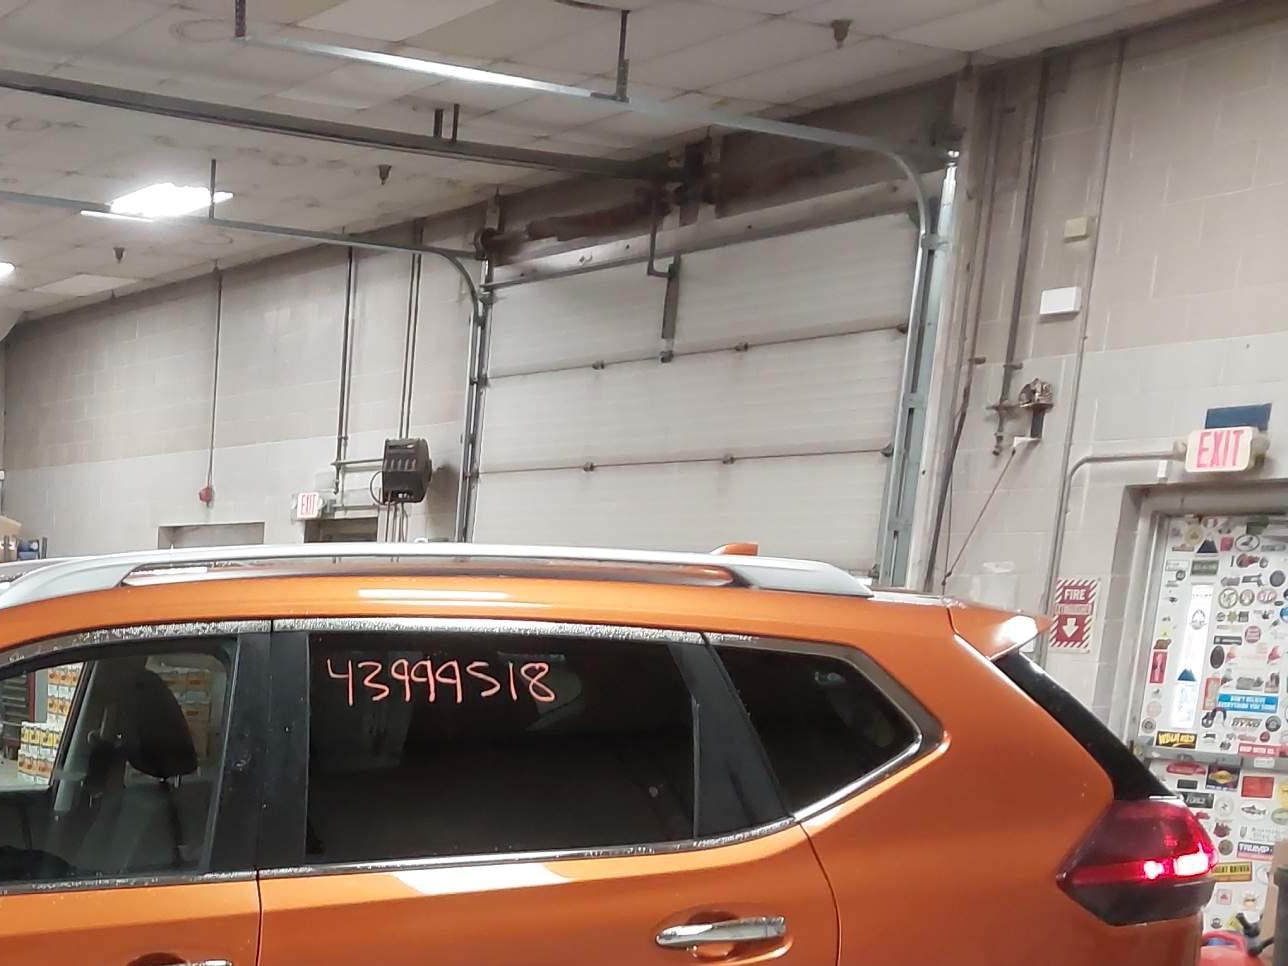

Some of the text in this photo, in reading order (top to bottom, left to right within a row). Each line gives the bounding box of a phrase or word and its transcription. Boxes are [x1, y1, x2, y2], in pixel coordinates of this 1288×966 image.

[1196, 430, 1245, 468] EXIT
[301, 494, 317, 515] EXIT
[1064, 589, 1086, 600] FIRE
[327, 657, 556, 706] 43999518
[1239, 843, 1270, 853] TRUMP
